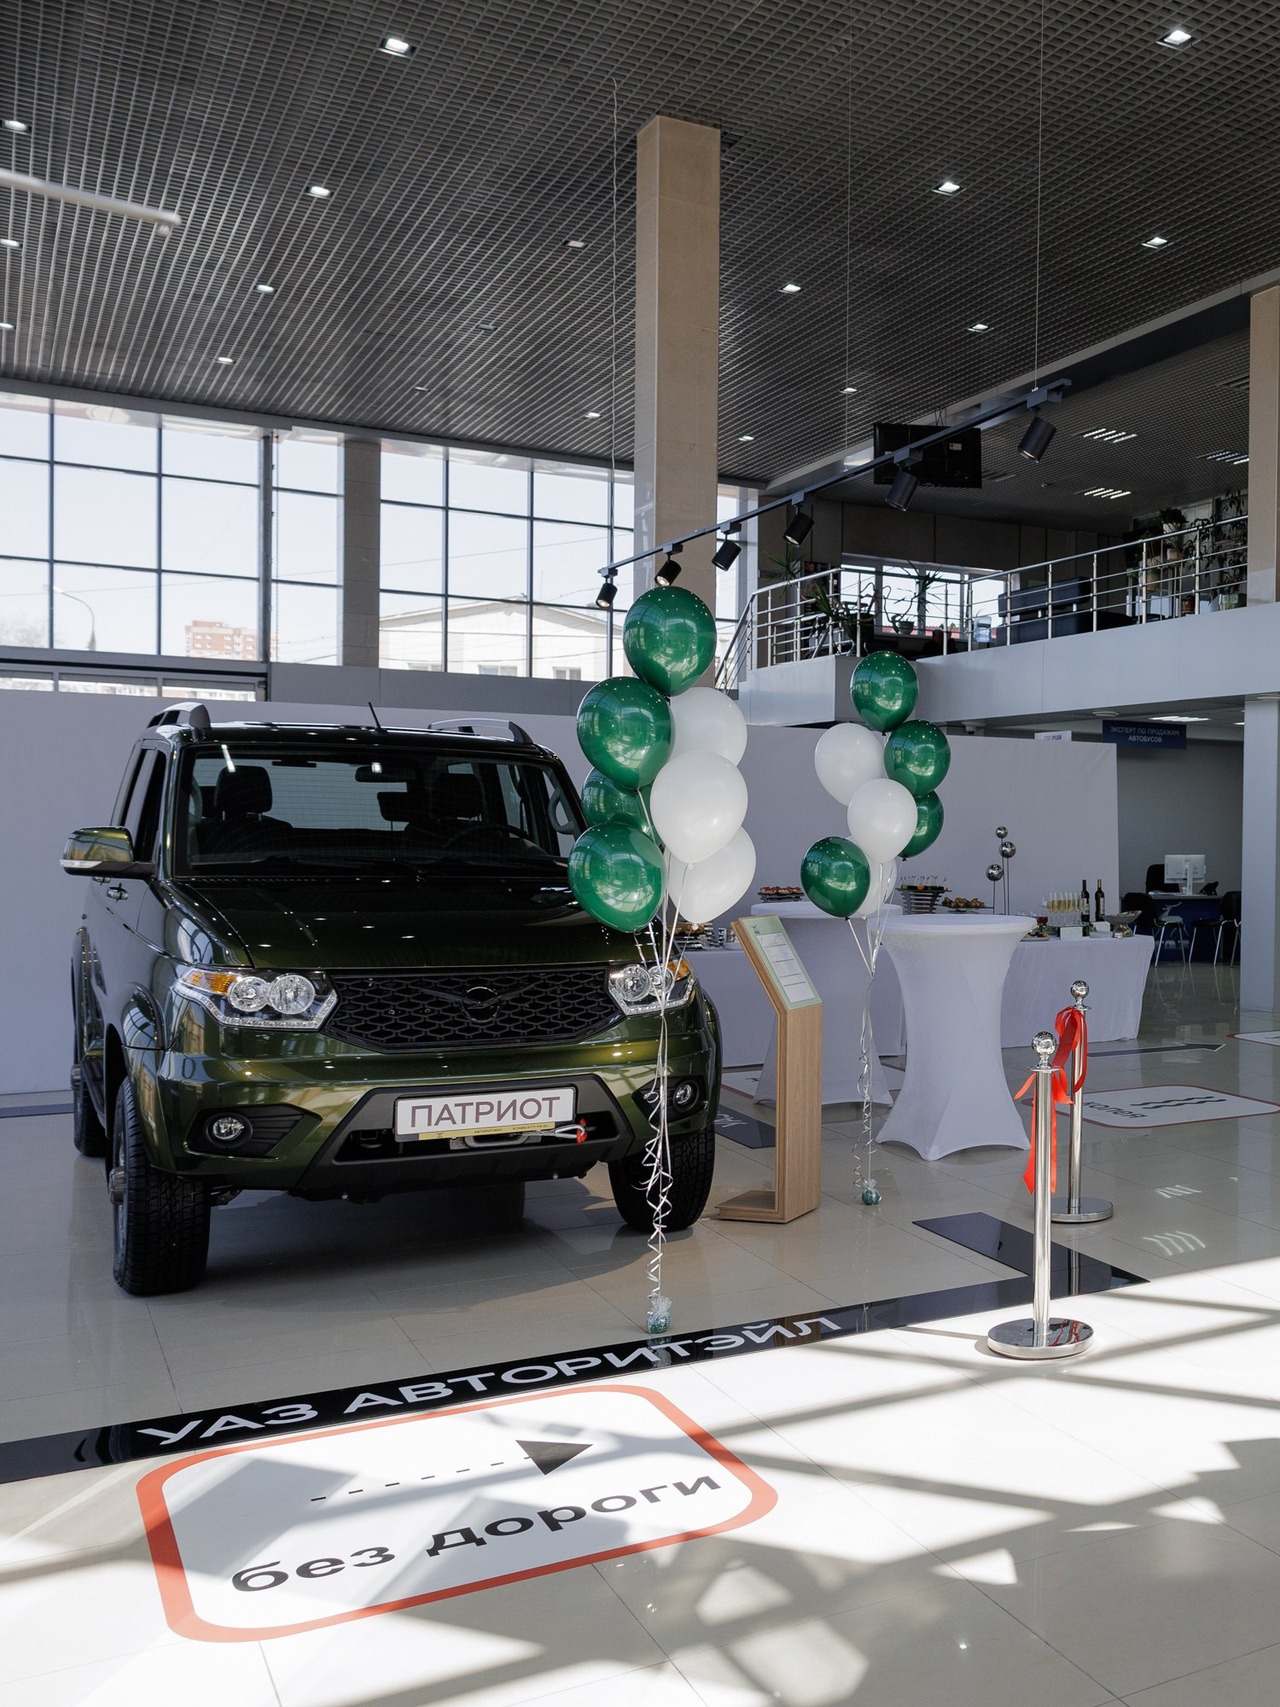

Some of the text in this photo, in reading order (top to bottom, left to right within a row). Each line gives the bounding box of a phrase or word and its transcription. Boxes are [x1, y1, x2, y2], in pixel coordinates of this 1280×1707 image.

[1110, 726, 1136, 734] ЭКСПЕРТ
[1128, 735, 1162, 743] АВТОБУСОВ
[411, 1097, 560, 1127] ПАТРИОТ
[137, 1316, 842, 1446] УАЗ АВТОРИТЭЙЛ
[231, 1474, 722, 1592] без дороги
